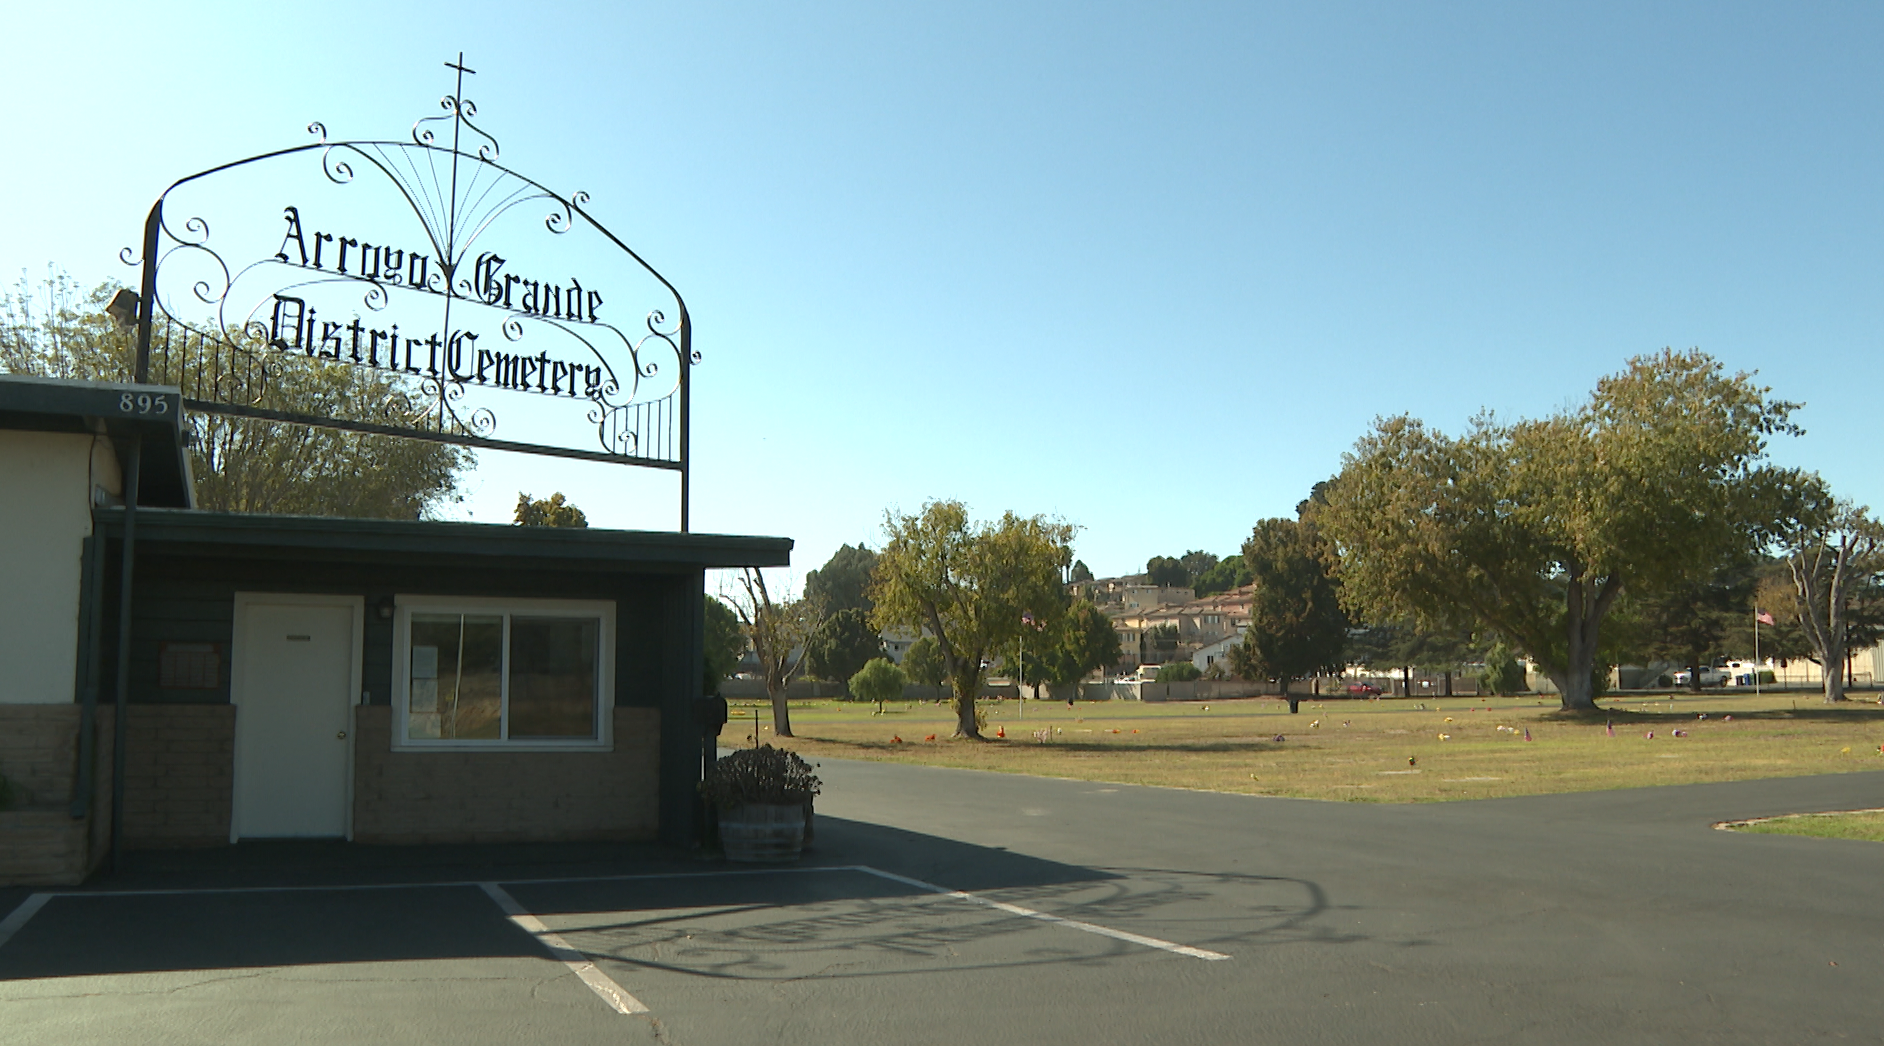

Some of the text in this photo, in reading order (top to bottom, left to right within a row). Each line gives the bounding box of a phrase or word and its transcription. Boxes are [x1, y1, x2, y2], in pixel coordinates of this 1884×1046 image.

[275, 205, 604, 323] Arroyo Grande
[268, 293, 602, 401] District Cemetery
[119, 392, 169, 415] 895
